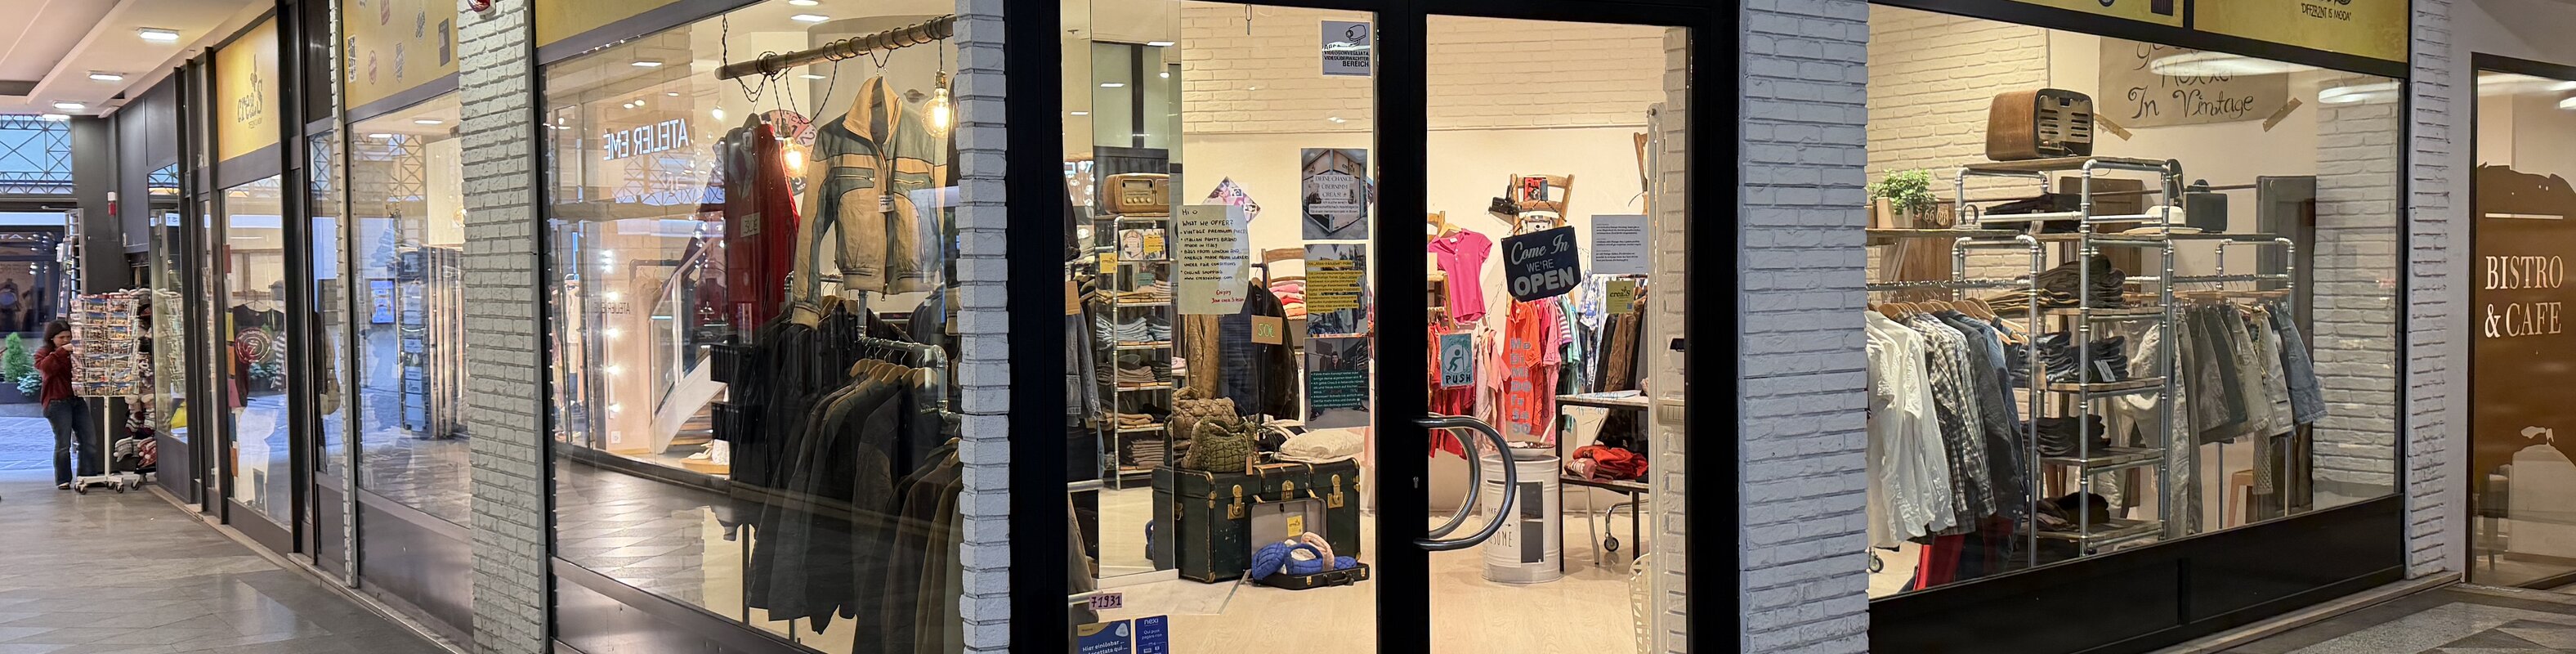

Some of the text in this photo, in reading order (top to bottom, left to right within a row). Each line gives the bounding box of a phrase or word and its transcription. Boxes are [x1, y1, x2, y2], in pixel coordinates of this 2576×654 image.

[2127, 85, 2254, 119] In Vintage
[1924, 208, 1934, 222] 66
[1511, 234, 1569, 265] Come In
[1526, 258, 1554, 273] WE'RE
[2484, 255, 2564, 289] BISTRO
[1514, 266, 1575, 296] OPEN
[2484, 302, 2561, 338] & CAFE
[1258, 323, 1275, 338] 50€
[1510, 353, 1524, 365] Di
[1446, 374, 1471, 384] PUSH
[1091, 595, 1122, 608] 71931
[1094, 641, 1119, 650] einlösbar
